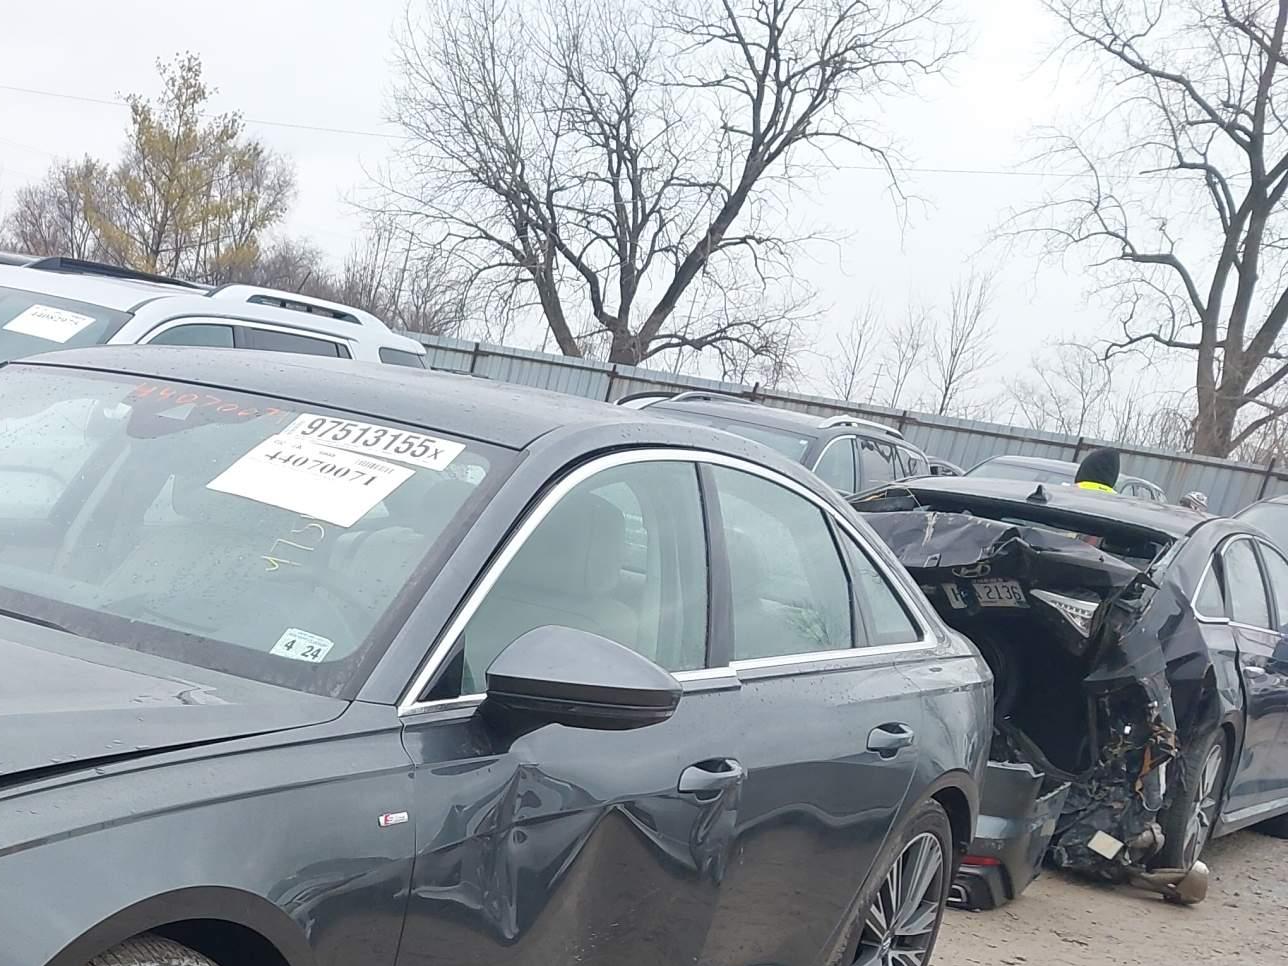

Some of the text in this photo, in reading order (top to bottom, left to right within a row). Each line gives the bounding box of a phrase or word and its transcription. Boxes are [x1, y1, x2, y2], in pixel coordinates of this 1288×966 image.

[264, 450, 379, 487] 44070071
[283, 638, 297, 652] 4
[300, 645, 322, 661] 24
